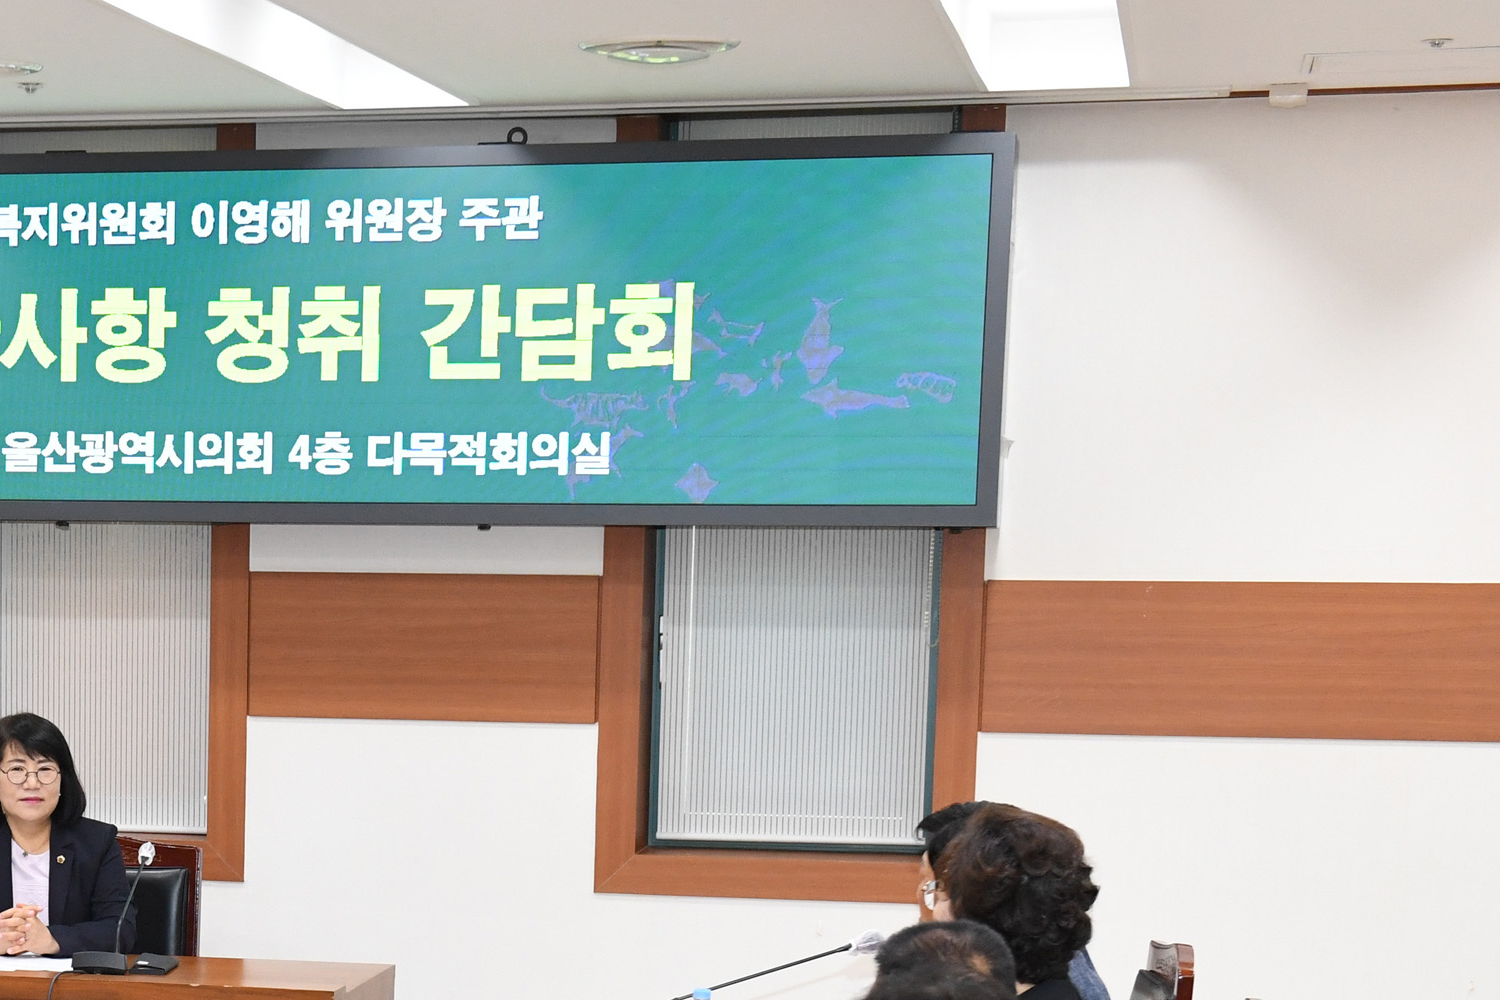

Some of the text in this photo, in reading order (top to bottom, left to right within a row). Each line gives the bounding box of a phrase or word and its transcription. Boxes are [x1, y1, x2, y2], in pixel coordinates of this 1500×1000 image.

[191, 199, 310, 245] 이영해
[325, 196, 448, 243] 위원장
[459, 195, 544, 242] 주관
[204, 285, 381, 384] 청취
[420, 282, 695, 382] 간담회
[1, 430, 611, 476] 울산광역시의회 4층 다목적회의실
